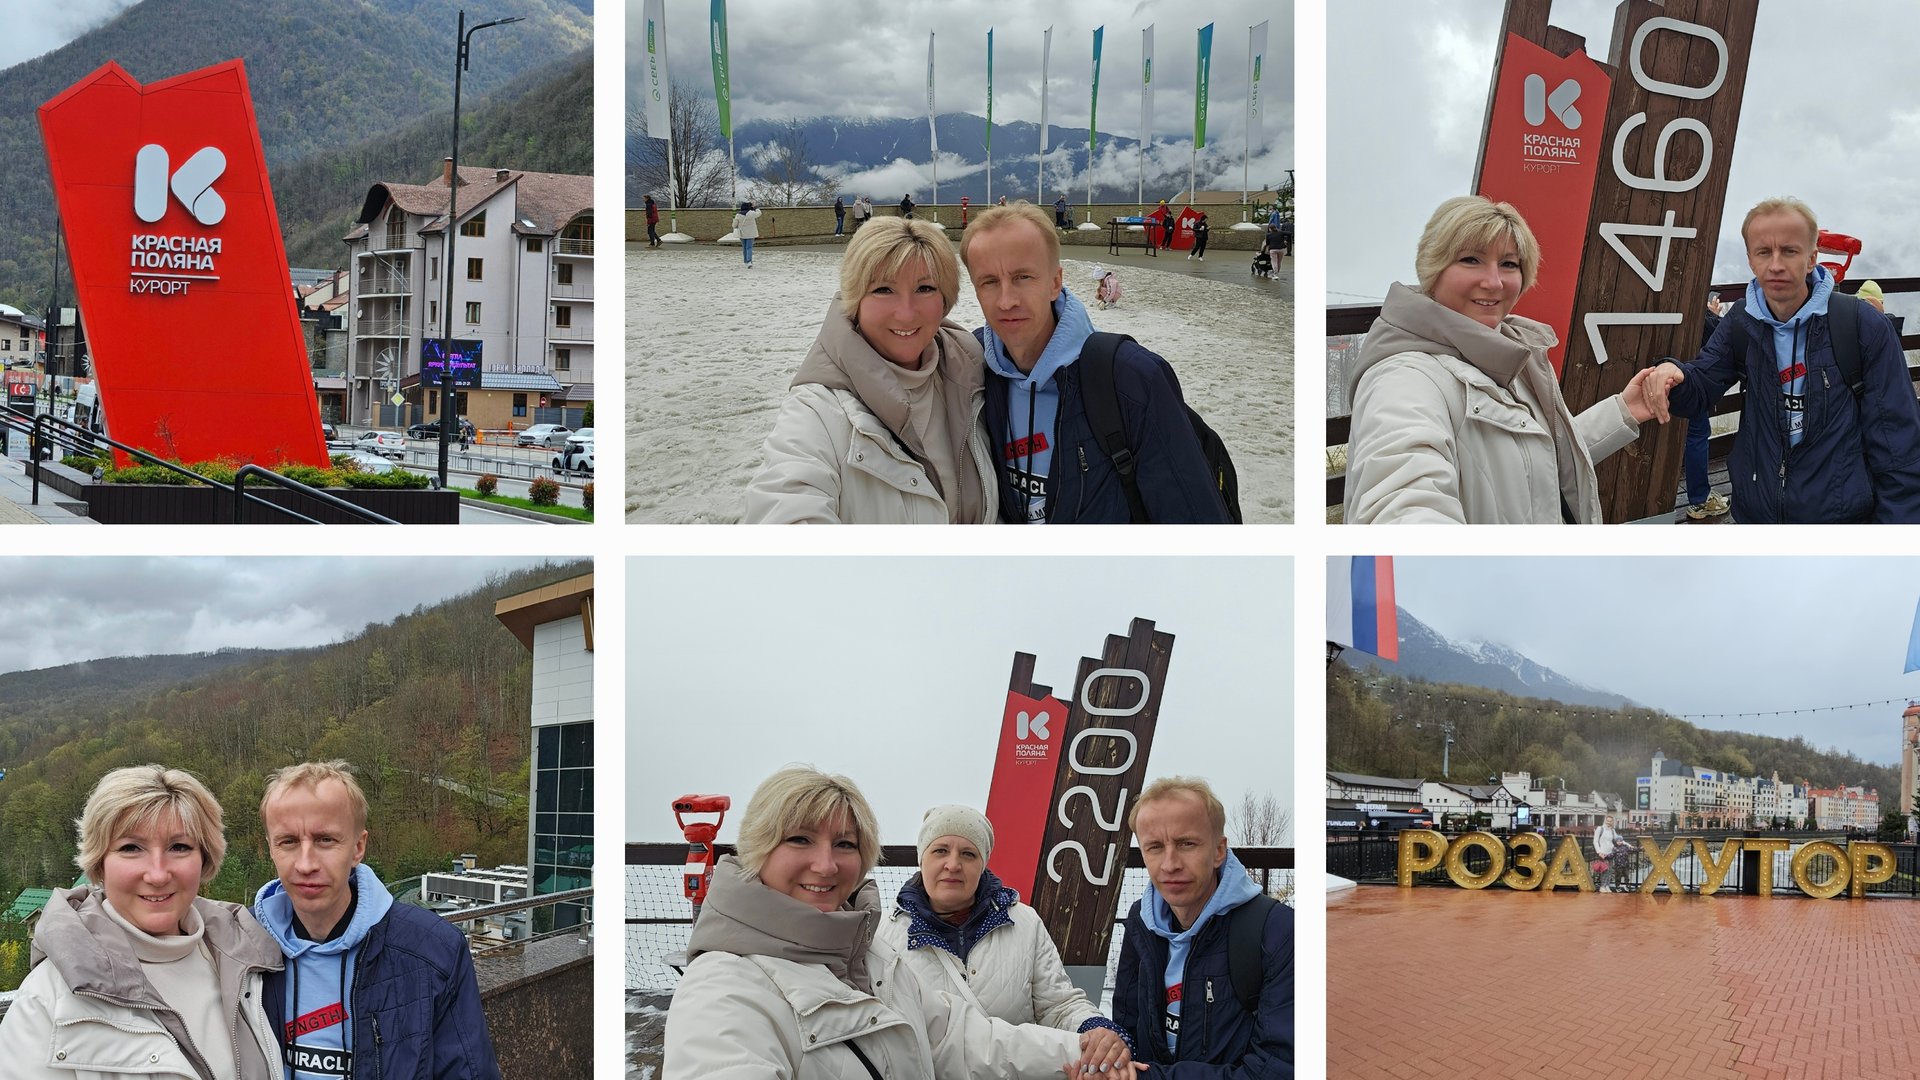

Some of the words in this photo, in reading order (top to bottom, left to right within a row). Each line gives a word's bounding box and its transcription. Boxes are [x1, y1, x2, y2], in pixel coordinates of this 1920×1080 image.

[1523, 133, 1581, 149] КРАСНАЯ
[1523, 145, 1577, 159] ПОЛЯНА
[1523, 163, 1561, 174] КУРОРТ
[1584, 16, 1729, 365] 1460
[131, 234, 222, 254] КРАСНАЯ
[131, 251, 215, 271] ПОЛЯНА
[129, 278, 191, 295] КУРОРТ
[1047, 668, 1151, 886] 2200
[1398, 829, 1597, 893] РОЗА
[1636, 835, 1897, 900] ХУТОР
